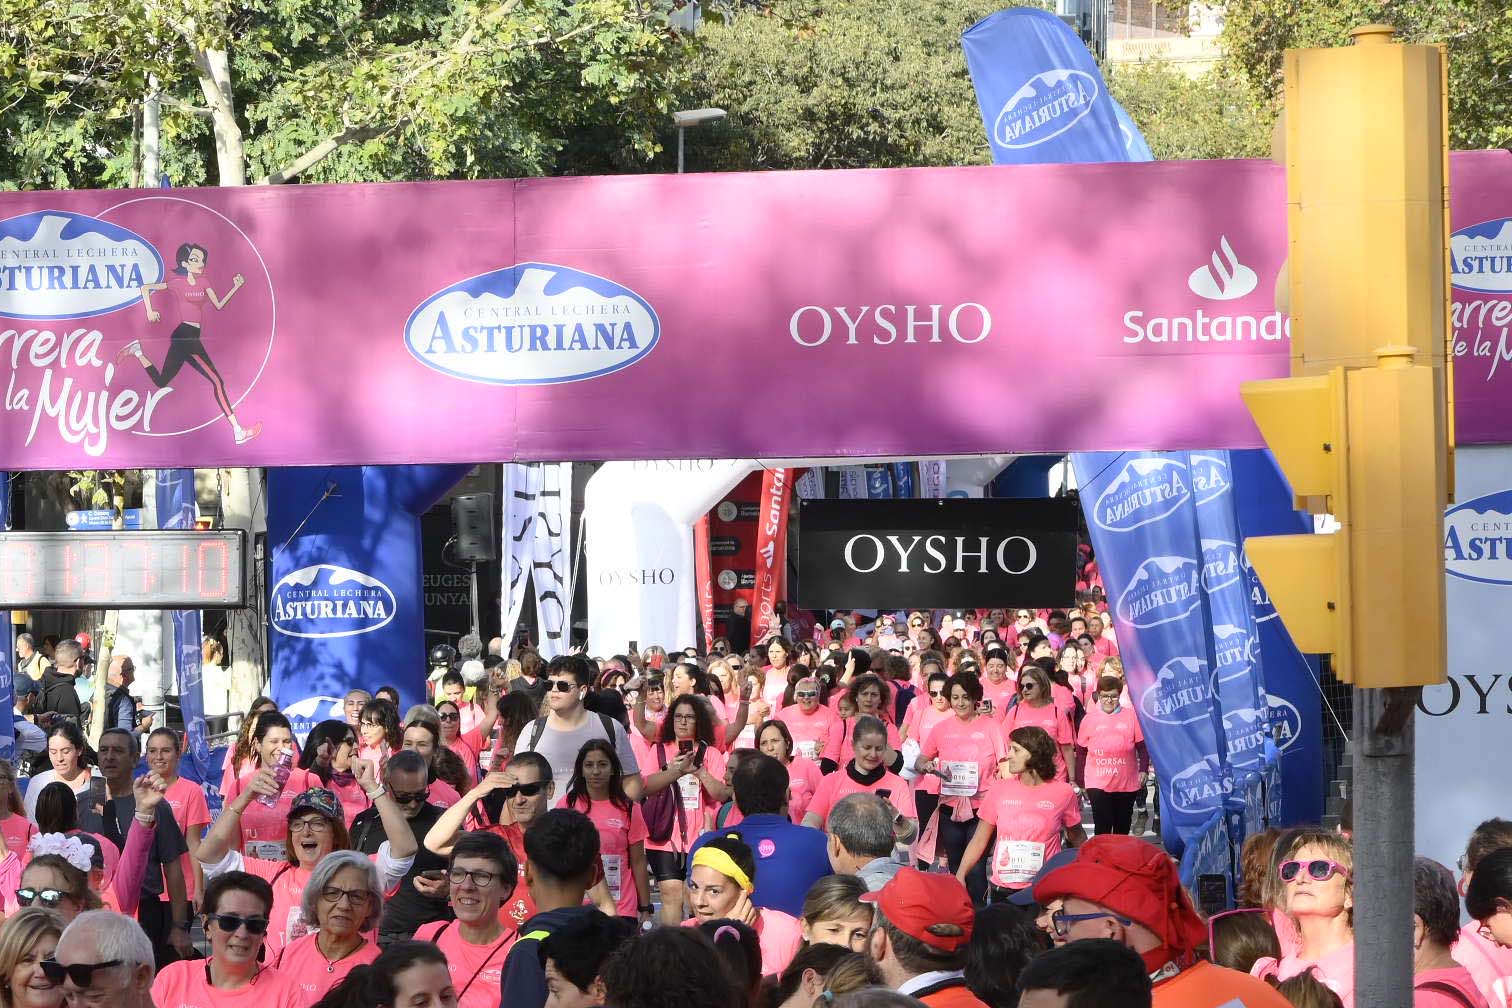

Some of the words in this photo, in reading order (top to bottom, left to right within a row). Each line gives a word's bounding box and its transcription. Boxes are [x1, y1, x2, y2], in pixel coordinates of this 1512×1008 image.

[66, 247, 140, 259] LECHERA
[464, 304, 542, 317] CENTRAL
[550, 303, 632, 316] LECHERA
[789, 302, 992, 348] OYSHO
[424, 311, 640, 355] ASTURIANA
[1122, 310, 1290, 344] Santand
[1473, 329, 1492, 357] la
[5, 371, 29, 411] la
[25, 362, 174, 457] Mujer
[843, 534, 1039, 575] OYSHO
[598, 567, 676, 586] OYSHO
[274, 593, 387, 622] ASTURIANA
[286, 589, 329, 599] CENTRAL
[333, 588, 383, 598] LECHERA
[1417, 674, 1512, 717] OY
